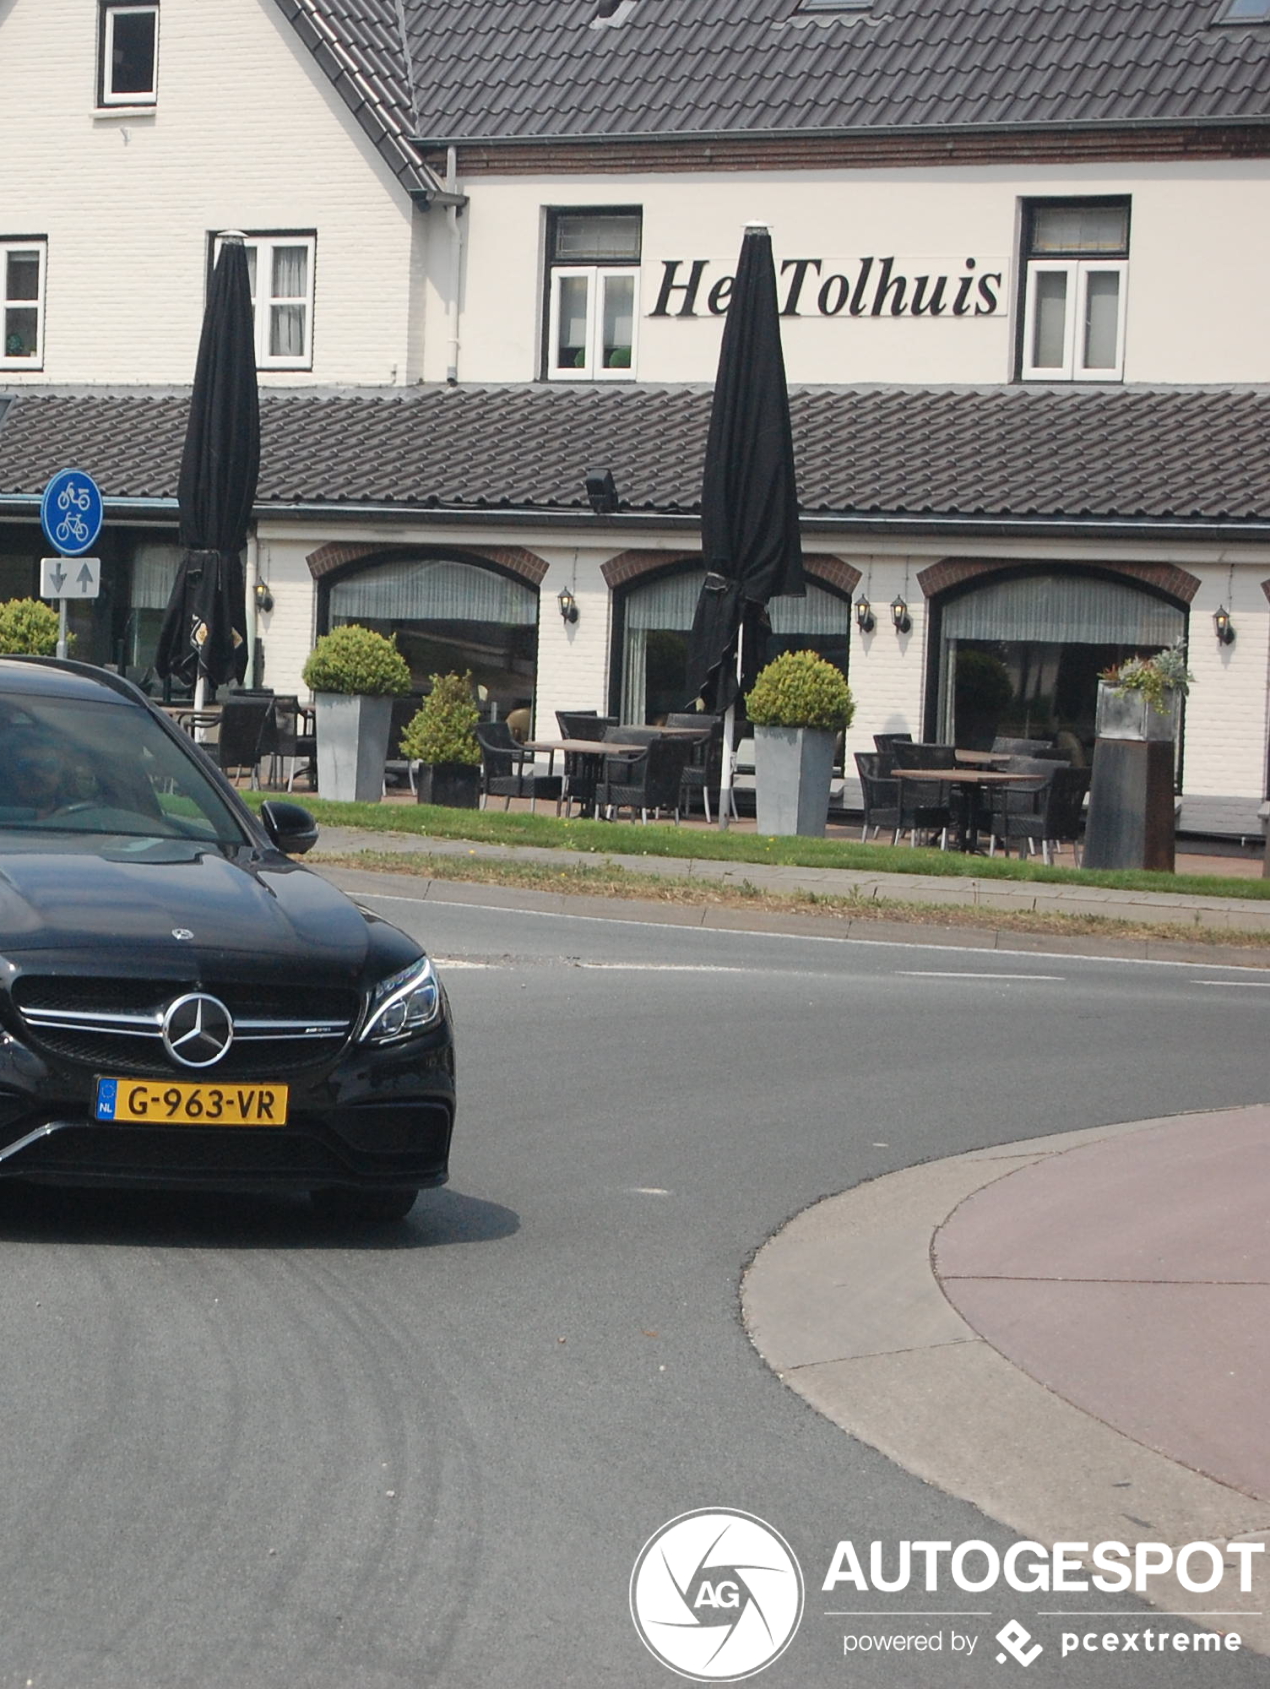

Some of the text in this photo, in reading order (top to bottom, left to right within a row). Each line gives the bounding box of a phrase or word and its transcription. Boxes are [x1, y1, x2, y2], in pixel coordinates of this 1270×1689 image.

[648, 256, 1002, 318] He Tolhuis
[99, 1102, 113, 1113] NL
[128, 1086, 275, 1119] G-963-VR
